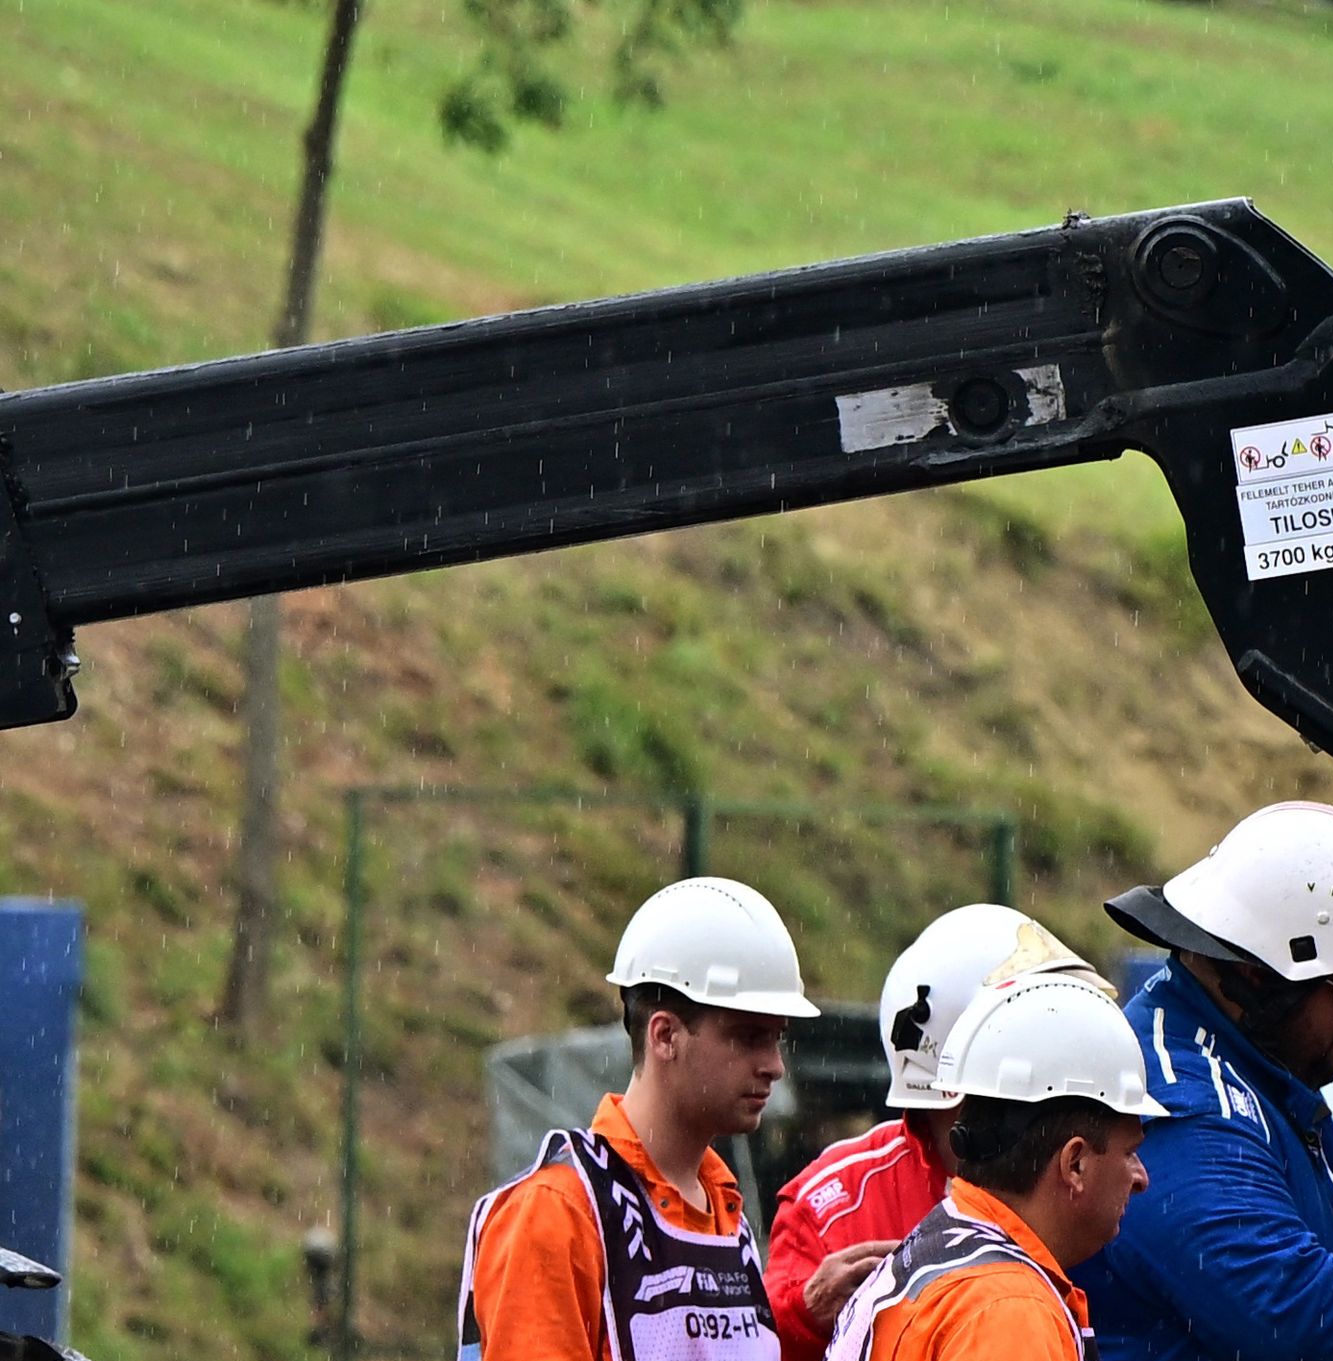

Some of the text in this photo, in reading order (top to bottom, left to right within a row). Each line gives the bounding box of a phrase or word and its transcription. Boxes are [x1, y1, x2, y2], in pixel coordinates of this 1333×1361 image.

[1240, 485, 1290, 501] FELEMELT
[1293, 479, 1325, 493] TEHER
[1258, 546, 1306, 570] 3700
